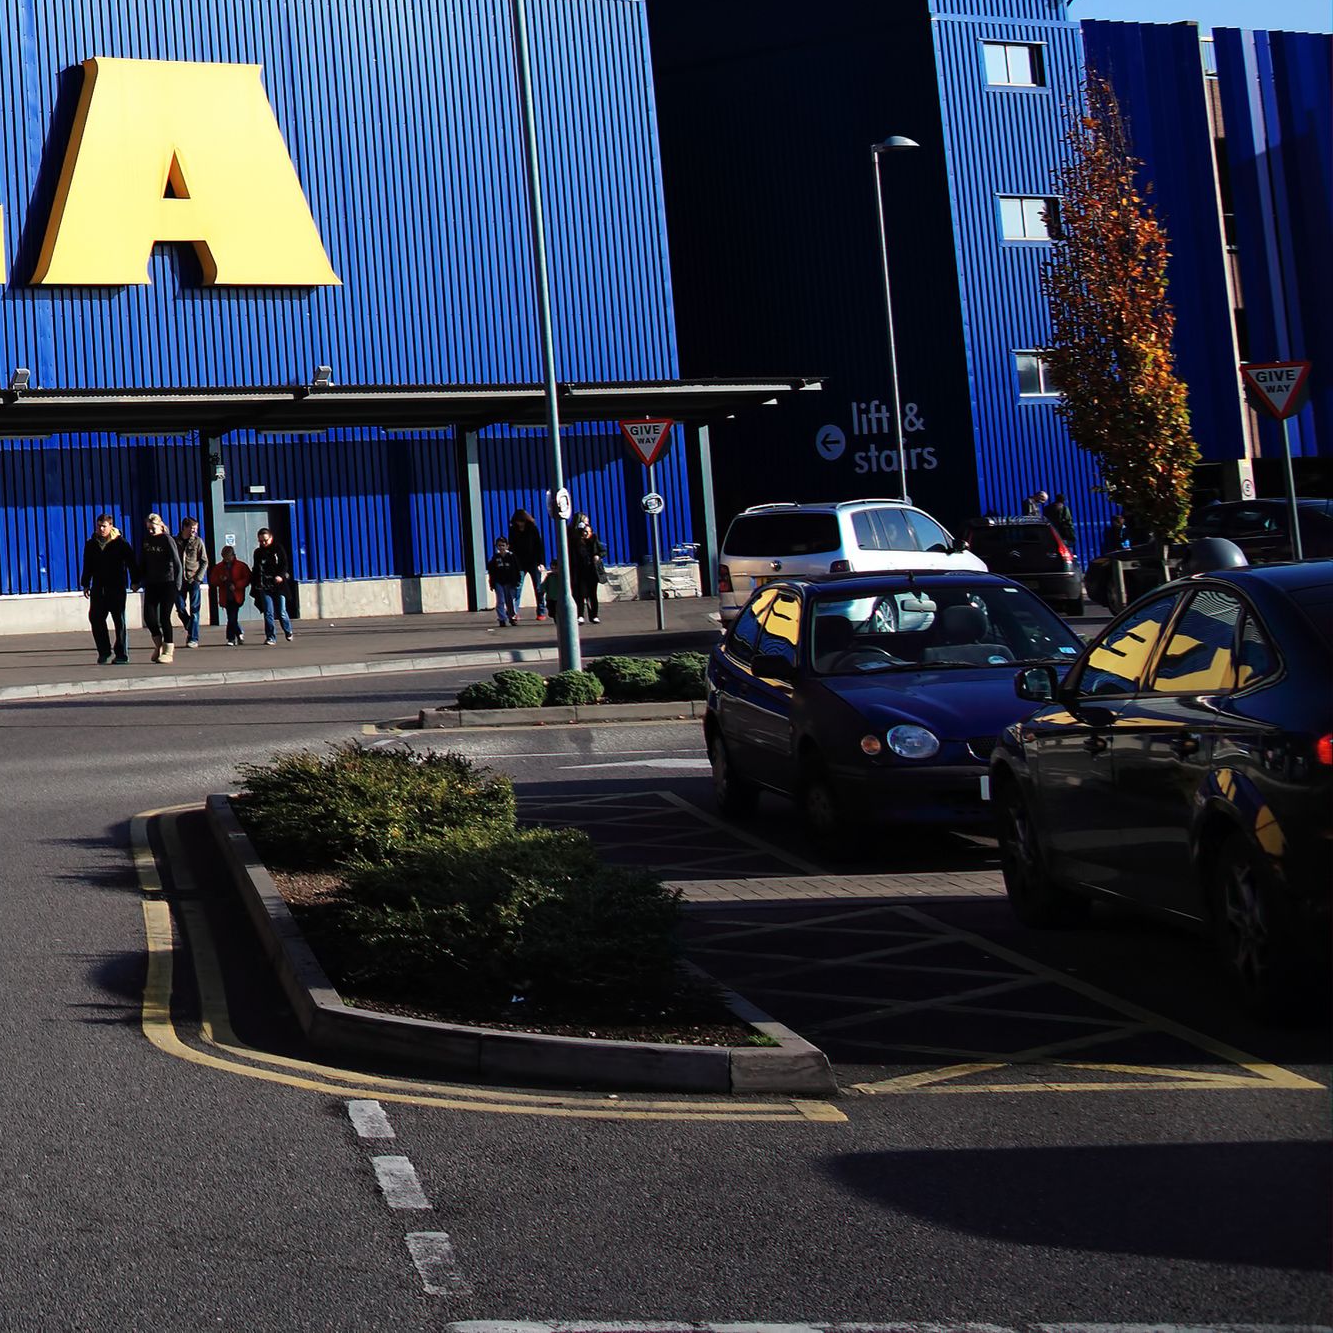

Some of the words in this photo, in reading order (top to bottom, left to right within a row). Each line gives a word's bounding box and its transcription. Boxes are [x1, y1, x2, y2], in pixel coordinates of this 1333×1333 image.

[1255, 369, 1296, 383] GIVE
[1265, 384, 1292, 393] WAY
[851, 400, 890, 435] lift
[904, 402, 925, 432] &
[630, 425, 661, 436] GIVE
[854, 437, 938, 473] stairs
